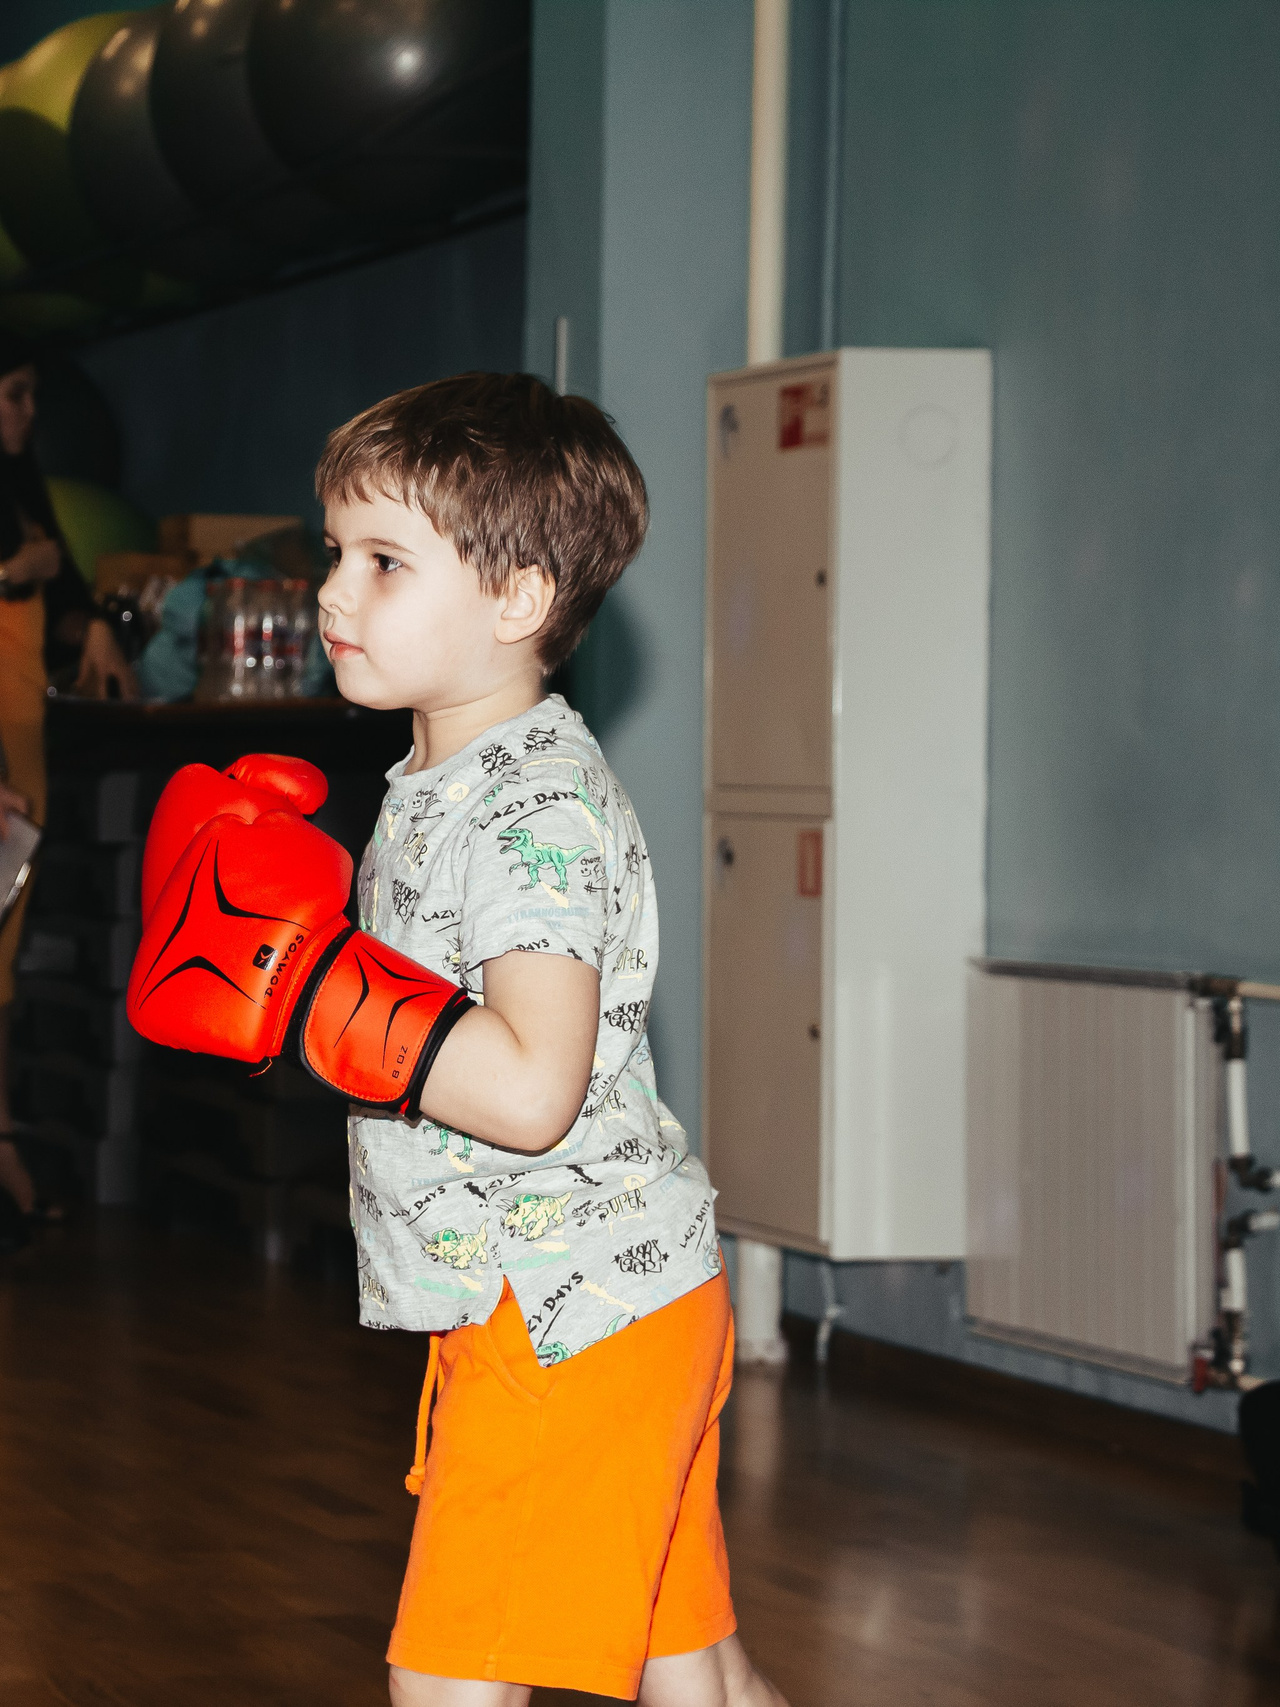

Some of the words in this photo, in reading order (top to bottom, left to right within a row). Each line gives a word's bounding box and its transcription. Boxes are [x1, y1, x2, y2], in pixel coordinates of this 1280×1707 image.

[479, 798, 529, 830] LAZY
[533, 791, 579, 805] DAYS
[422, 909, 458, 922] LAZY
[263, 933, 305, 998] DOMYOS
[397, 1045, 408, 1064] OZ
[590, 1074, 616, 1097] Fun
[414, 1185, 447, 1211] DAYS
[599, 1188, 647, 1222] SUPER
[679, 1224, 697, 1249] LAZY
[695, 1199, 710, 1223] DAYS
[526, 1310, 542, 1334] ZY
[543, 1271, 584, 1312] DAYS
